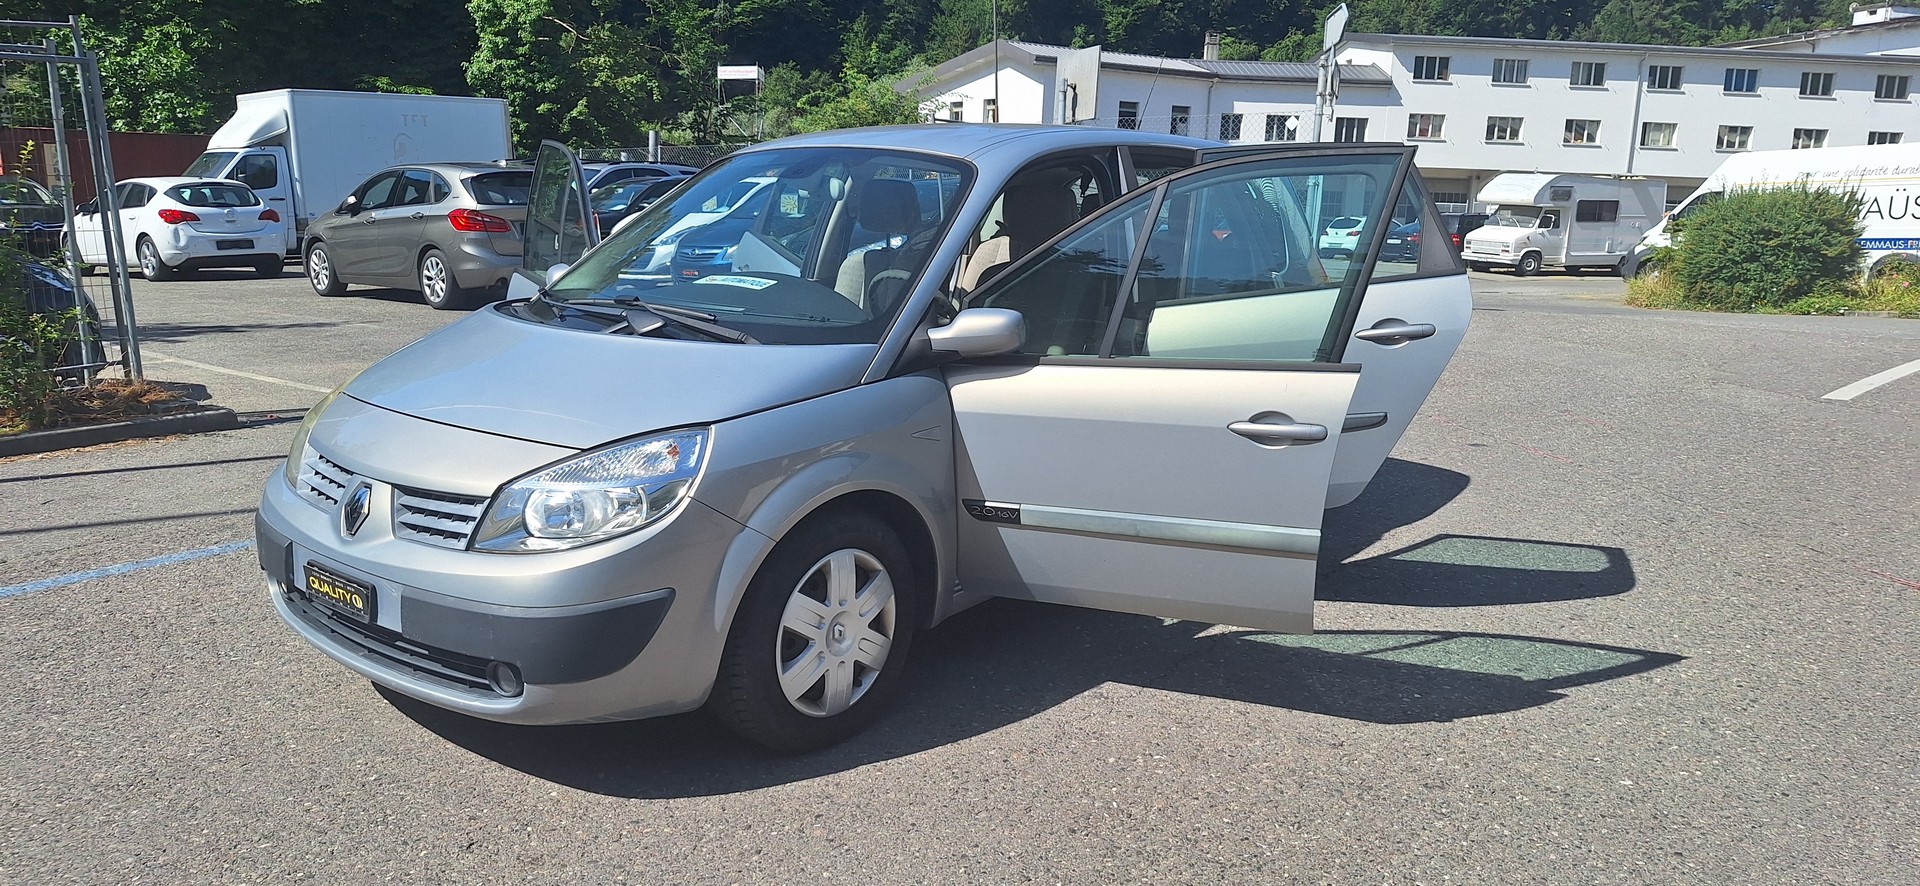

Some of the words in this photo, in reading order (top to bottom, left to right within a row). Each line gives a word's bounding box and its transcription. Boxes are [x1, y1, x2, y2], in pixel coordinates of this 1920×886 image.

[1859, 188, 1920, 220] AÜS
[970, 505, 996, 516] 2.0
[996, 510, 1019, 519] 16V
[309, 576, 351, 604] QUALITY
